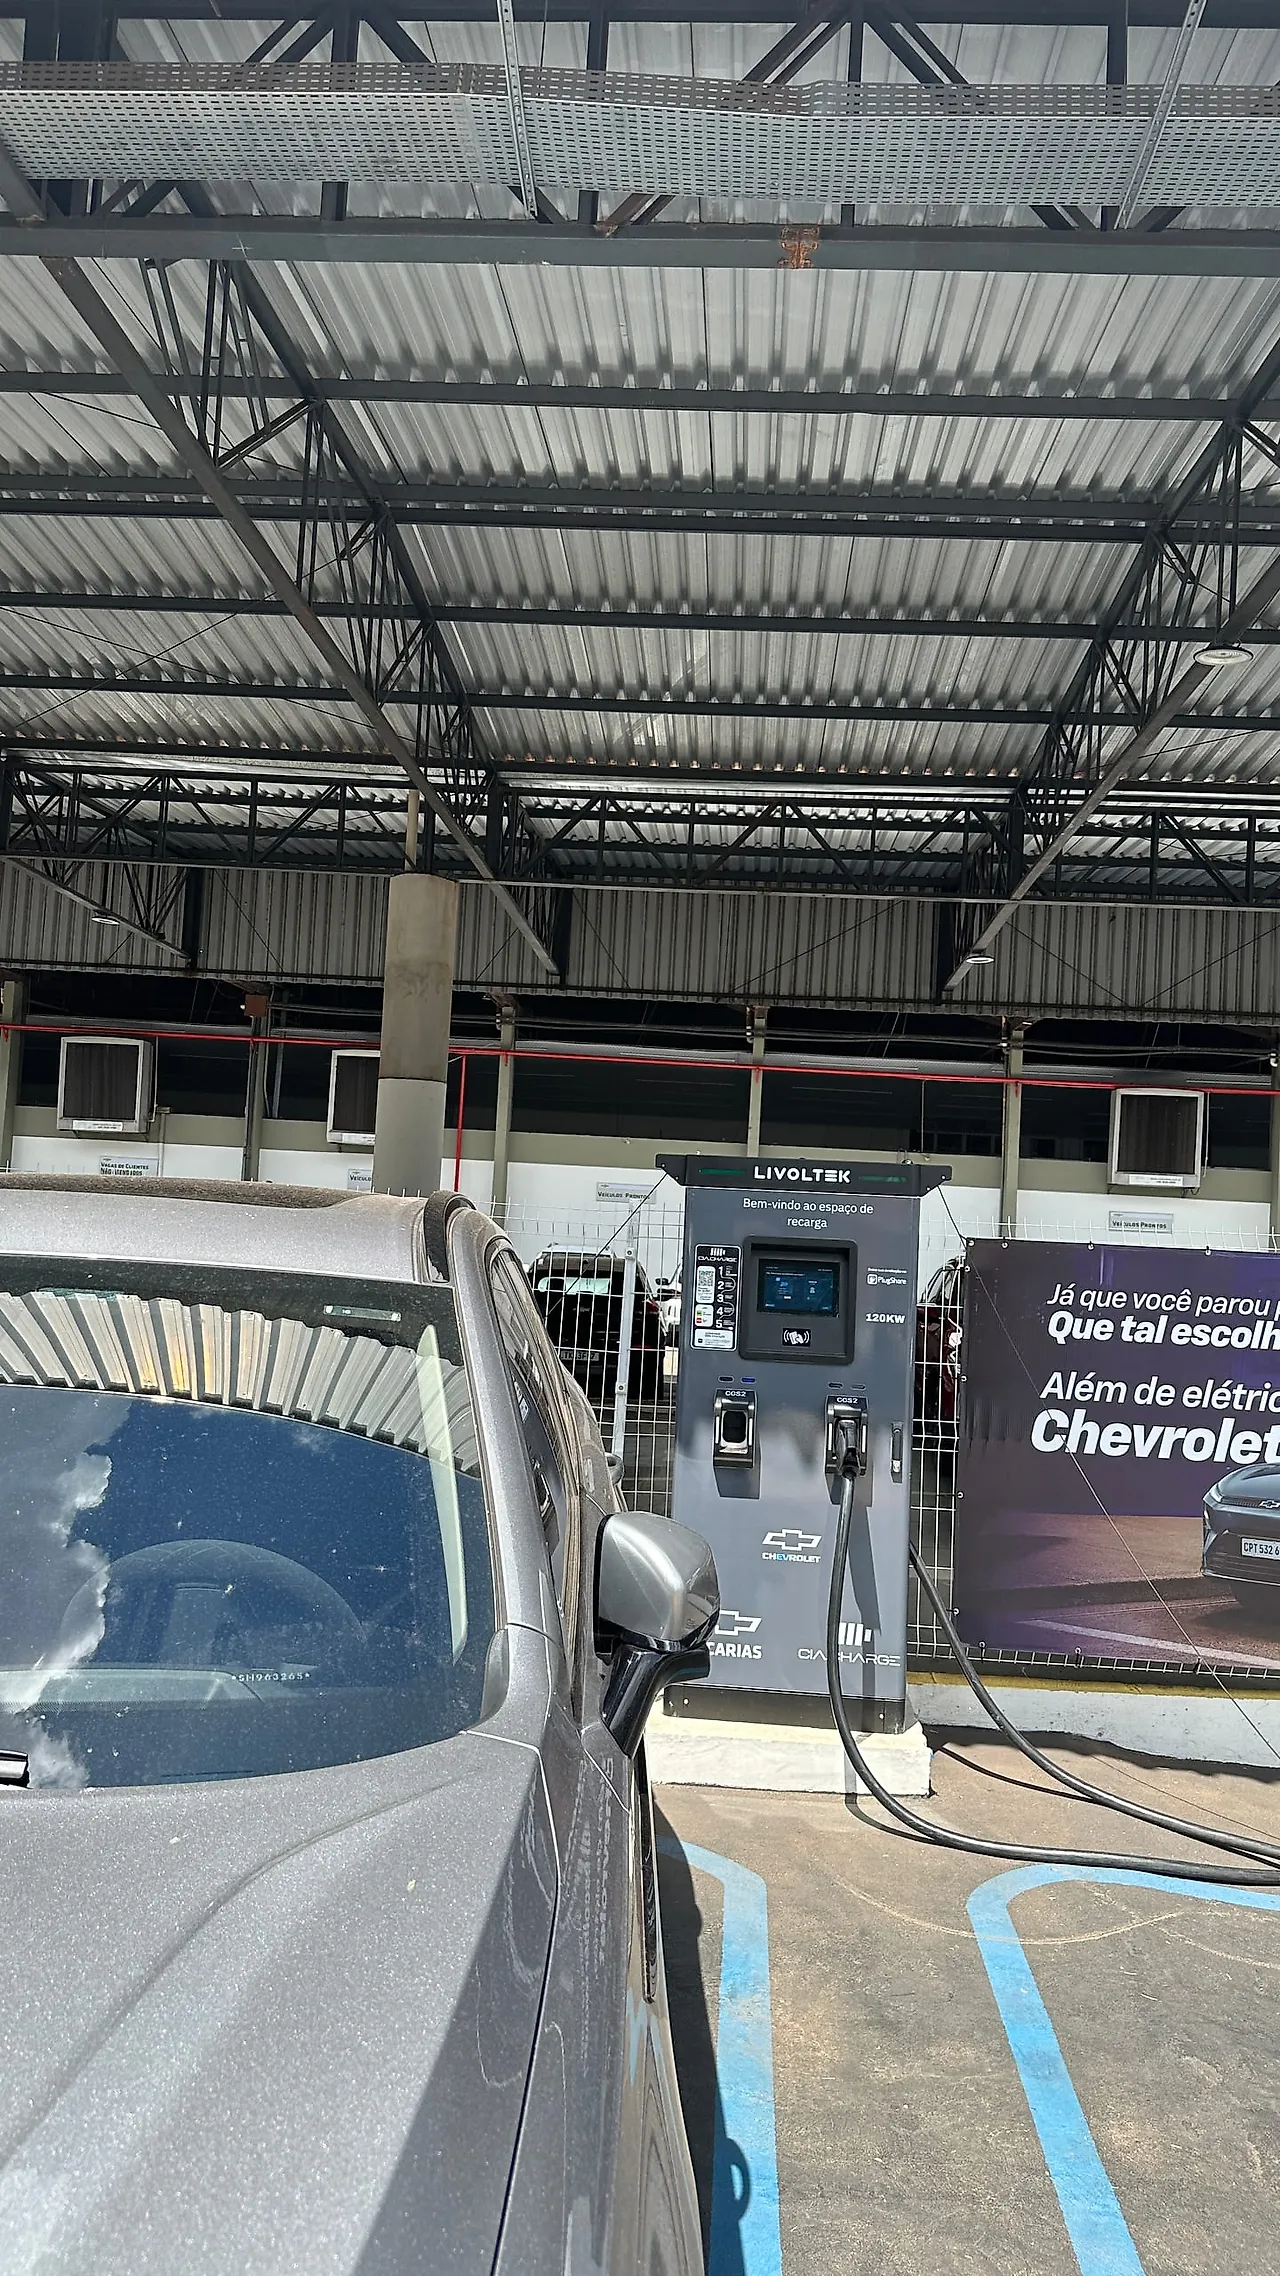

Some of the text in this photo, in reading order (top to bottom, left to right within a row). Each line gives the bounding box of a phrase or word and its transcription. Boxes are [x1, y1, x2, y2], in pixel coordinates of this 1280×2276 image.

[754, 1165, 851, 1183] LIVOLTEK
[743, 1198, 874, 1215] Bem-vindo ao espaço de
[787, 1217, 828, 1230] recarga
[717, 1281, 724, 1289] 2
[717, 1293, 723, 1302] 3
[1047, 1283, 1076, 1306] Já
[1079, 1289, 1128, 1311] que
[1133, 1288, 1192, 1312] você
[1195, 1294, 1271, 1317] parou
[716, 1307, 723, 1315] 4
[866, 1313, 906, 1324] 120KW
[716, 1320, 722, 1328] 5
[1047, 1310, 1280, 1350] Que tal escolh
[1039, 1371, 1127, 1404] Além
[1133, 1375, 1177, 1406] de
[1030, 1408, 1280, 1465] Chevrolet
[1259, 1544, 1274, 1556] 532
[762, 1552, 822, 1564] CHEVROLET
[705, 1641, 762, 1660] CARIAS
[797, 1648, 901, 1667] CIAHARGE
